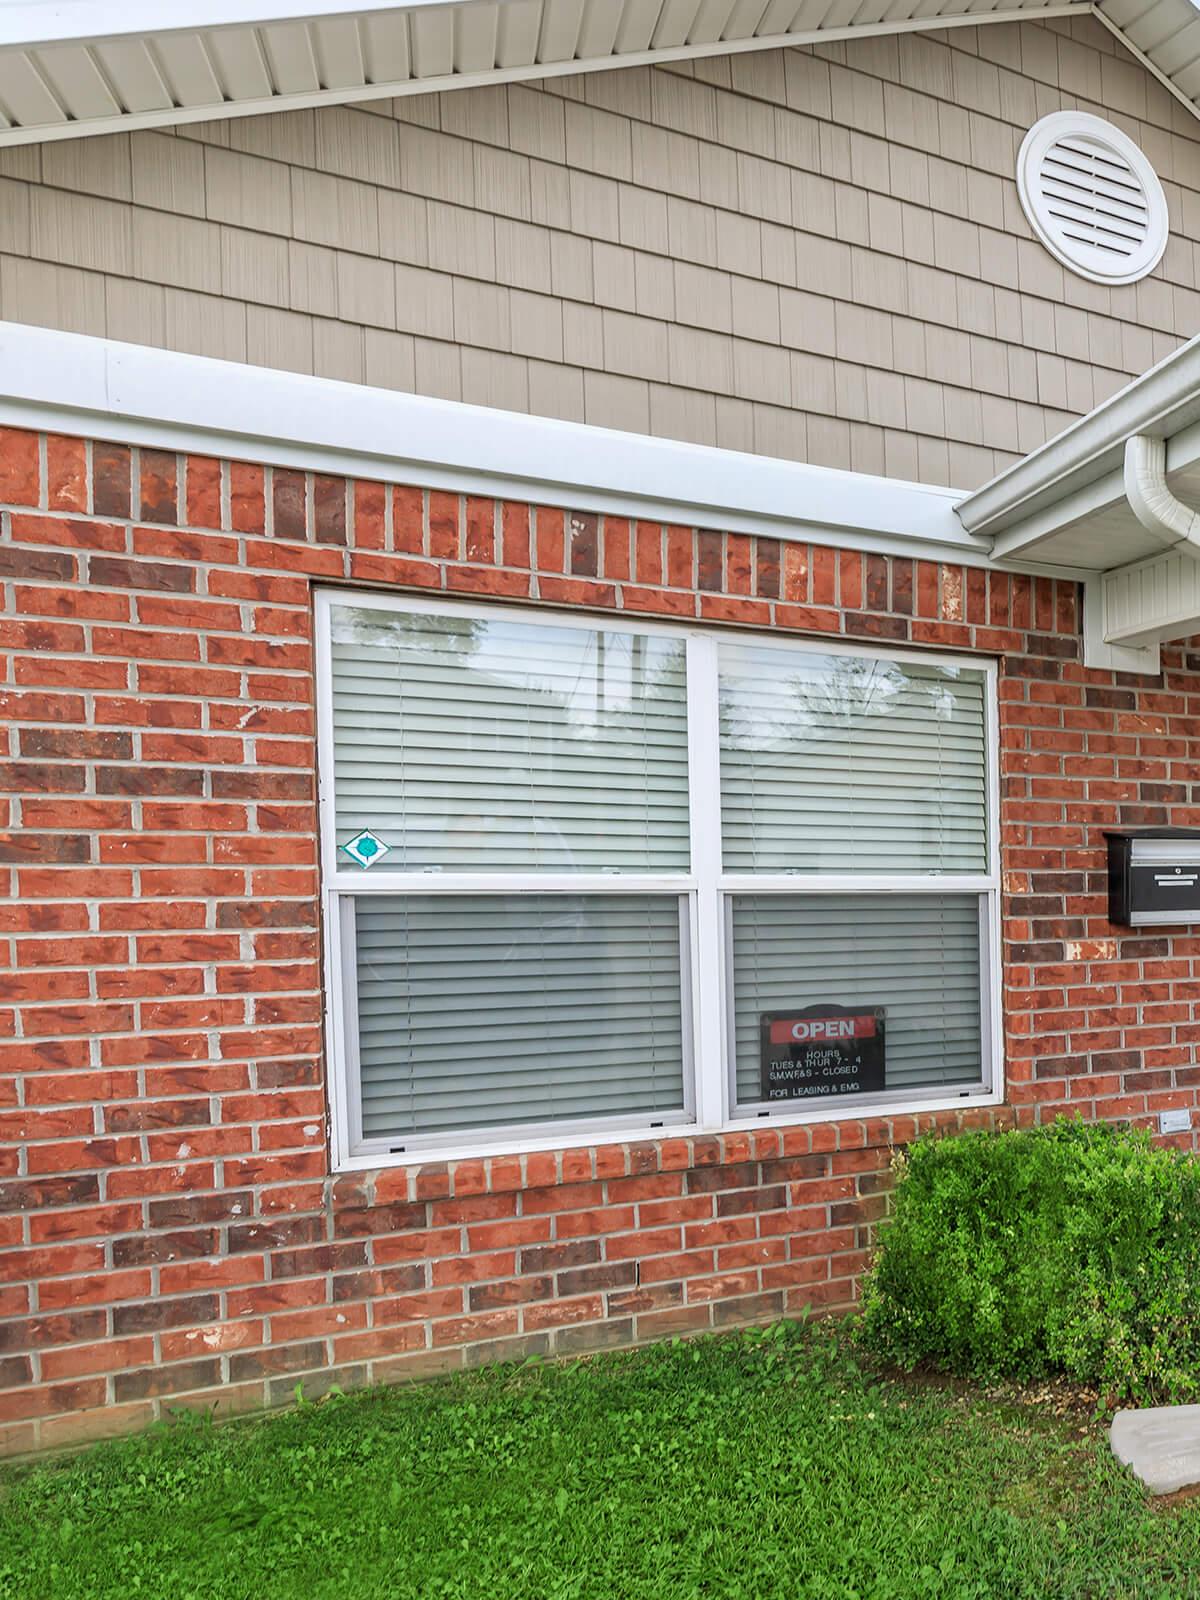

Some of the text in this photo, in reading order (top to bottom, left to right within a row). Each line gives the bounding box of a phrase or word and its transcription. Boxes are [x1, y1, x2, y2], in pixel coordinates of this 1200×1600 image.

[792, 1021, 854, 1038] OPEN
[806, 1050, 839, 1059] HOURS
[770, 1062, 793, 1070] TUES
[796, 1060, 802, 1068] &
[805, 1058, 830, 1067] THUR
[836, 1057, 842, 1065] 7
[822, 1066, 858, 1075] CLOSED
[792, 1085, 830, 1096] LEASING
[840, 1083, 859, 1091] EMG
